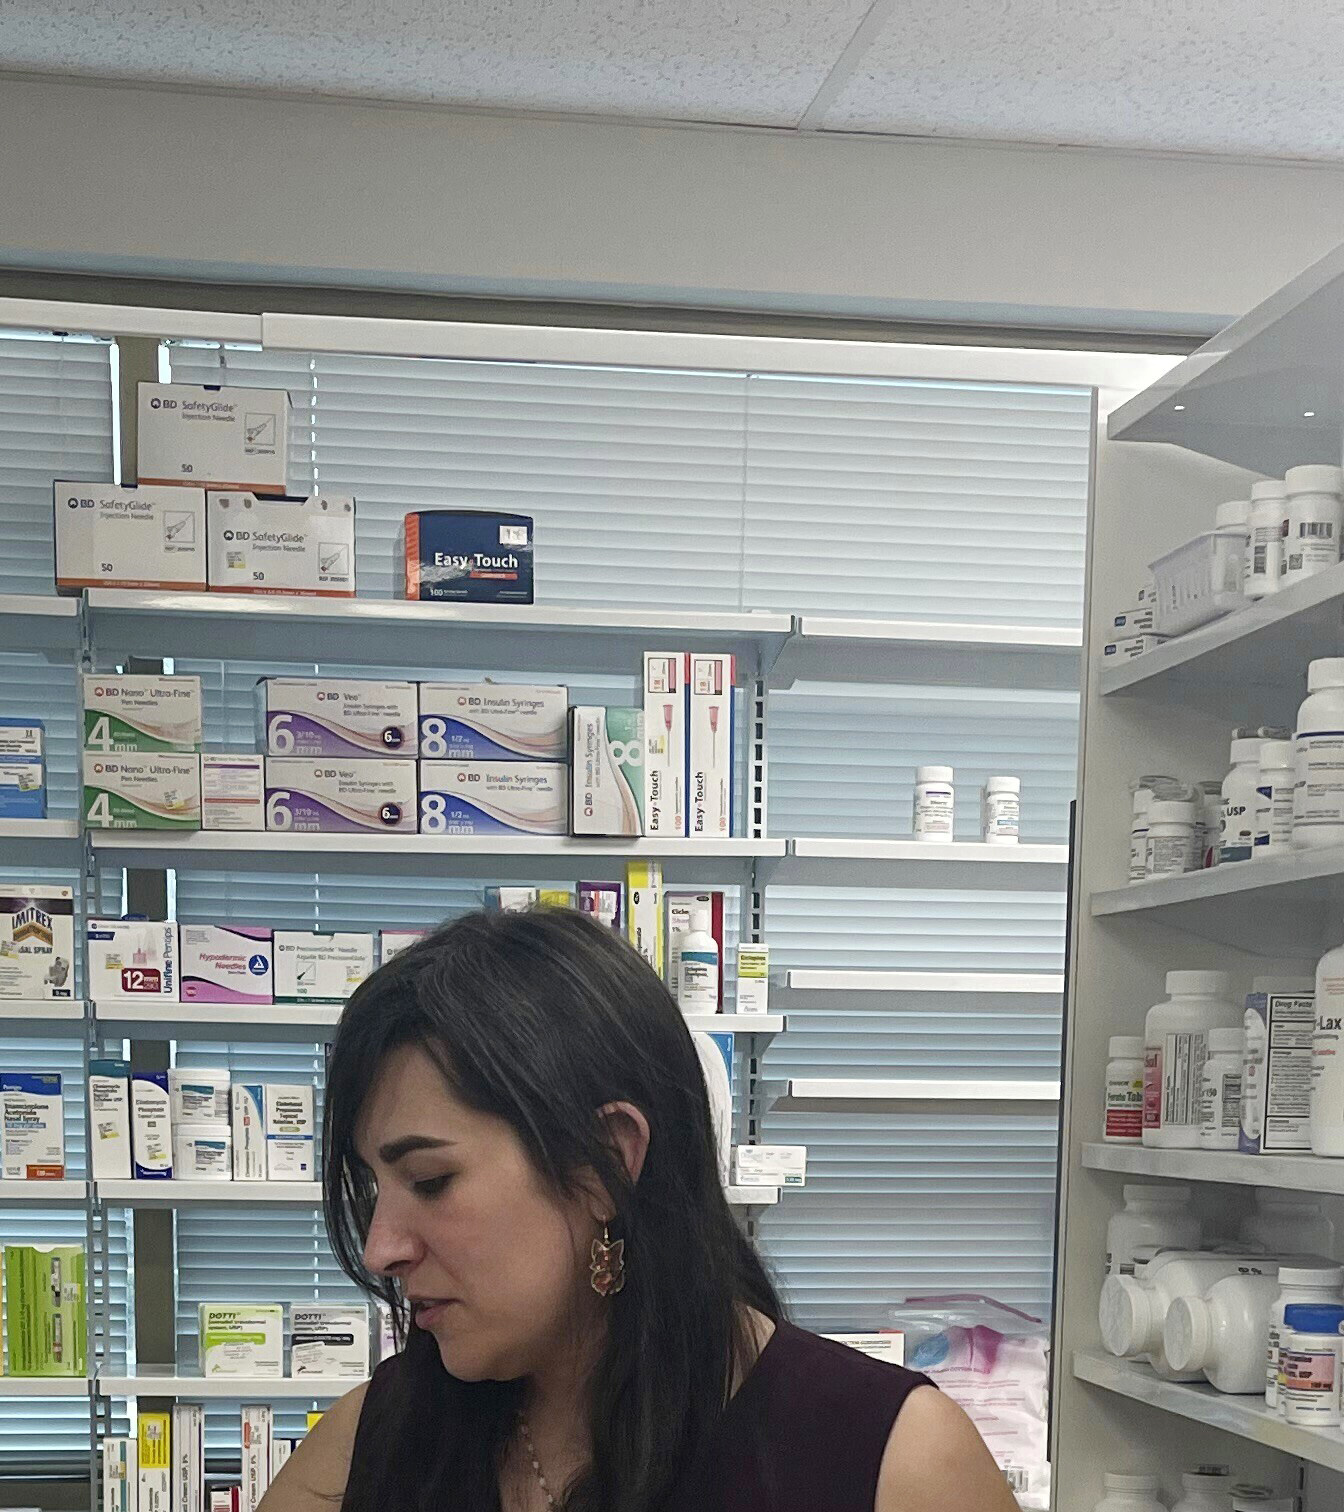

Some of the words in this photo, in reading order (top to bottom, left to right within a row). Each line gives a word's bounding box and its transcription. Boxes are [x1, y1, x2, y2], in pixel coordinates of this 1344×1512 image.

[163, 400, 177, 409] BD
[181, 464, 193, 473] 50
[80, 499, 94, 508] BD
[236, 531, 250, 541] BD
[101, 563, 113, 572] 50
[435, 553, 468, 569] Easy
[474, 554, 518, 568] Touch
[253, 572, 265, 580] 50
[327, 692, 339, 700] BD
[512, 699, 544, 709] Syringes
[87, 717, 114, 751] 4
[268, 715, 295, 756] 6
[421, 717, 447, 758] 8
[106, 765, 118, 773] BD
[324, 770, 336, 778] BD
[467, 774, 480, 782] BD
[515, 775, 548, 786] Syringes
[650, 770, 659, 800] Touch
[695, 771, 704, 804] Touch
[87, 793, 114, 828] 4
[267, 792, 293, 831] 6
[421, 794, 447, 835] 8
[650, 806, 660, 831] Easy
[695, 806, 705, 832] Easy
[12, 907, 53, 930] IMITREX
[123, 971, 144, 989] 12
[164, 958, 173, 994] Unifine
